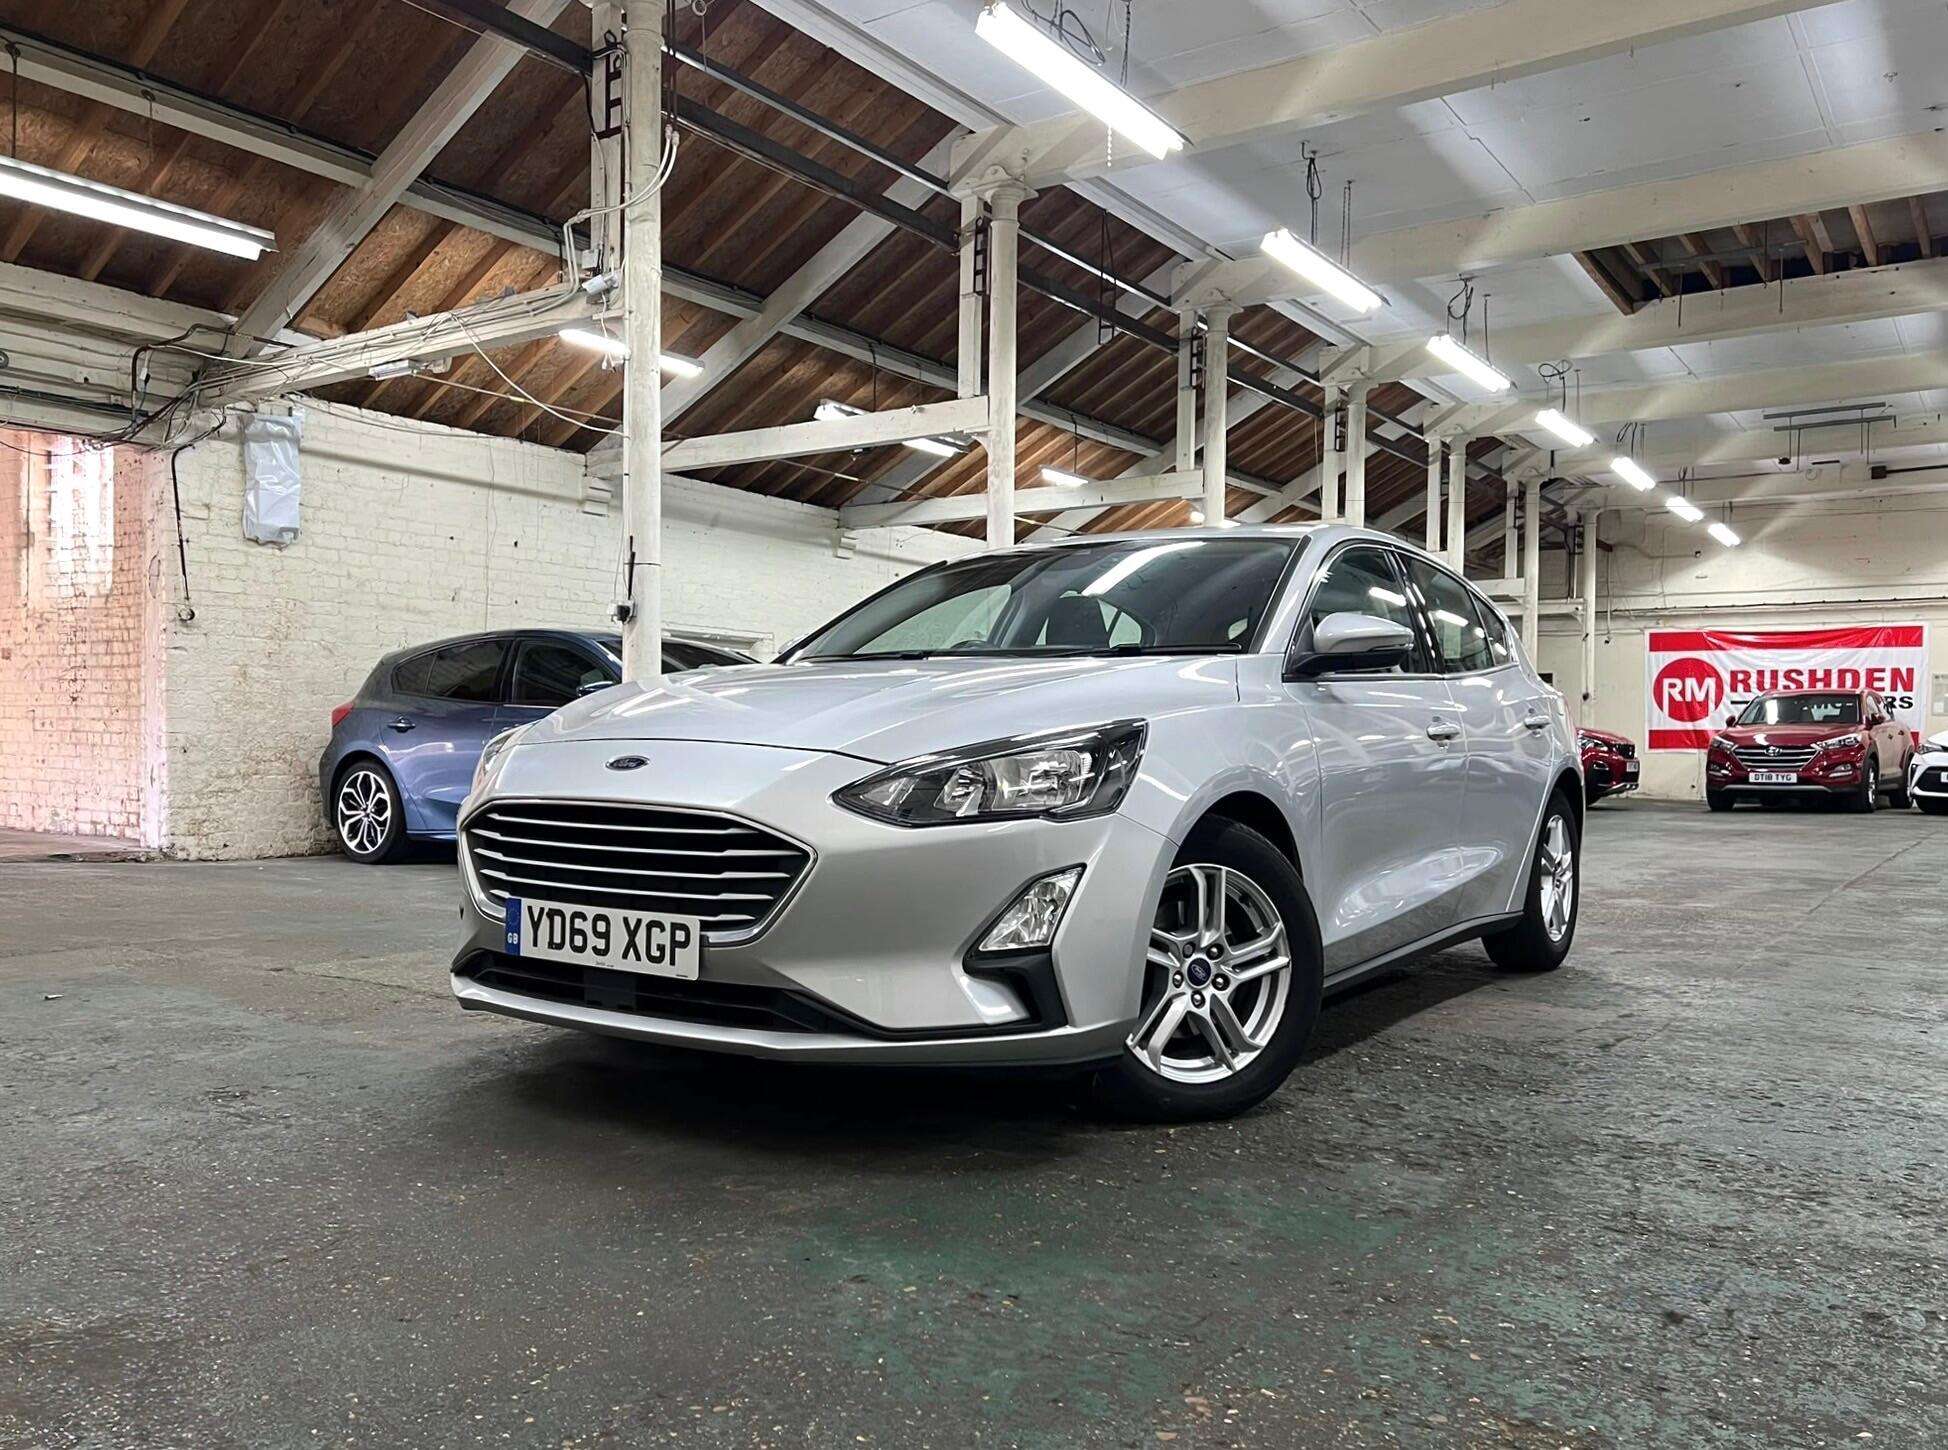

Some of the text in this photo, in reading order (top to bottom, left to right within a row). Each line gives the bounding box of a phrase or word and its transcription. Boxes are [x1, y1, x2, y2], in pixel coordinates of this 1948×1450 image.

[1730, 667, 1915, 693] RUSHDEN
[1663, 677, 1716, 717] RM
[507, 932, 519, 945] GB
[527, 905, 691, 966] YD69 XGP
